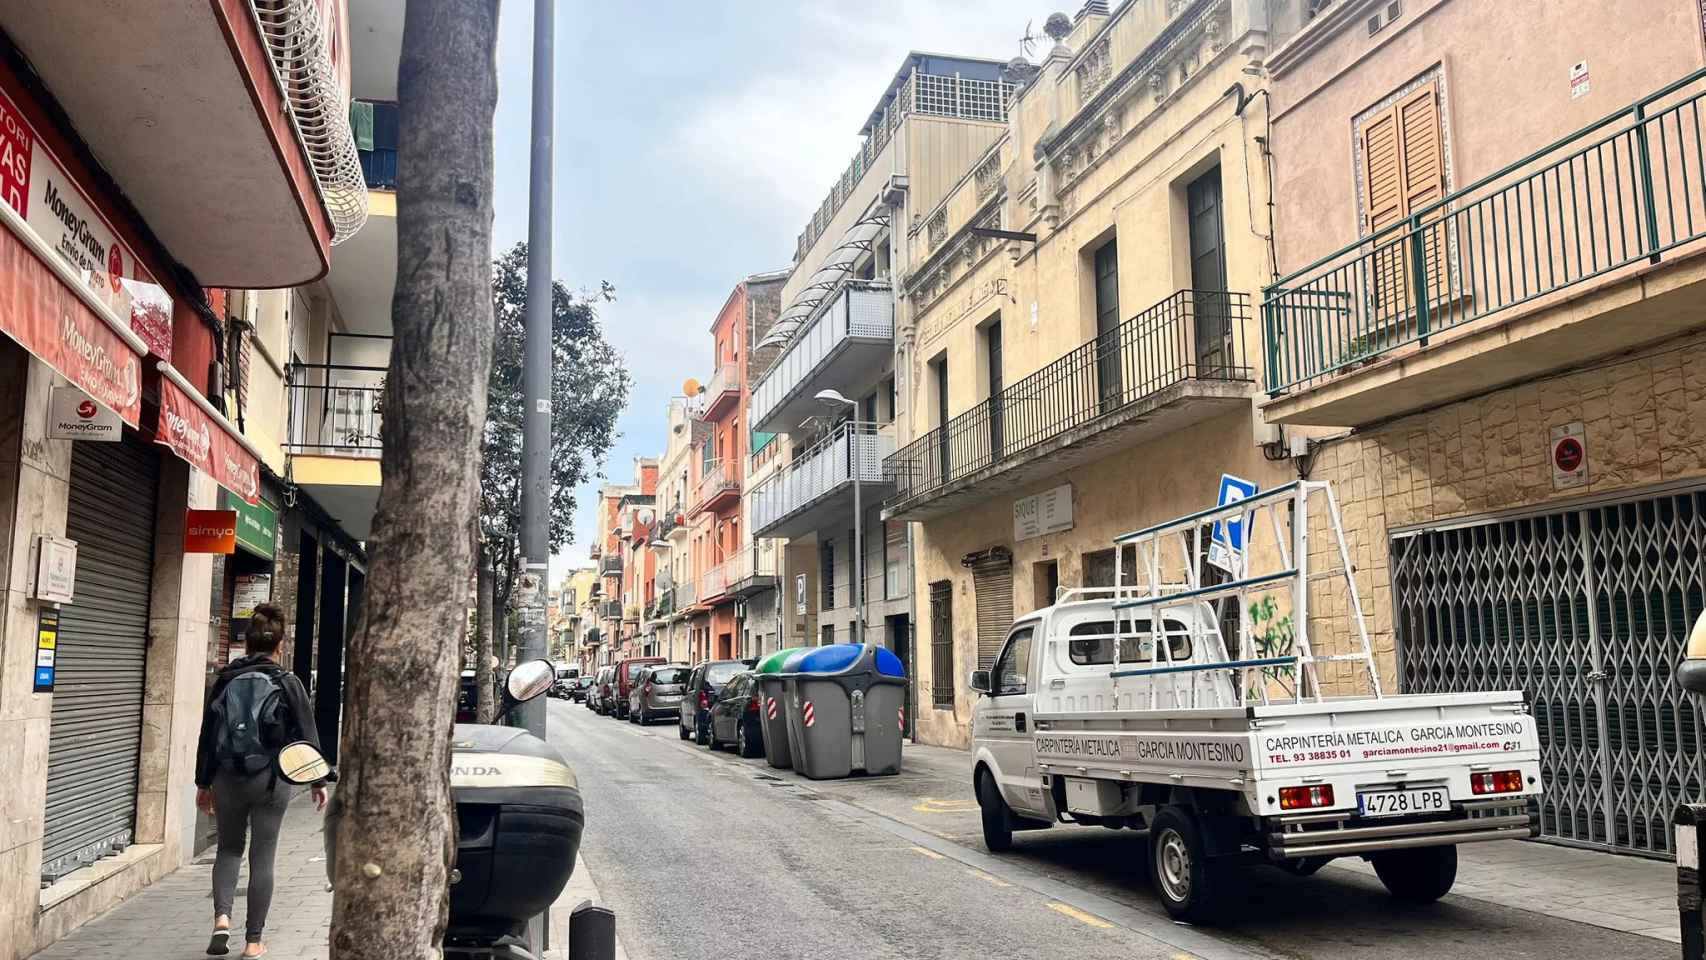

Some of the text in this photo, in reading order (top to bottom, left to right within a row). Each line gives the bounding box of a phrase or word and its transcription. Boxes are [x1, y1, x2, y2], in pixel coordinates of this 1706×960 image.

[44, 179, 105, 265] MoneyGram
[57, 423, 113, 432] MoneyGram
[188, 525, 234, 539] simyo
[1346, 730, 1404, 746] METALICA
[1410, 727, 1455, 741] GARCIA
[1455, 722, 1523, 738] MONTESINO
[1081, 739, 1120, 757] METALICA
[1138, 740, 1175, 759] GARCIA
[1175, 740, 1244, 762] MONTESINO
[1269, 754, 1291, 764] TEL.
[1293, 752, 1306, 762] 93
[1308, 750, 1338, 761] 38835
[1339, 749, 1351, 758] 01
[449, 766, 502, 776] NDA
[1366, 791, 1443, 812] 4728 LPB
